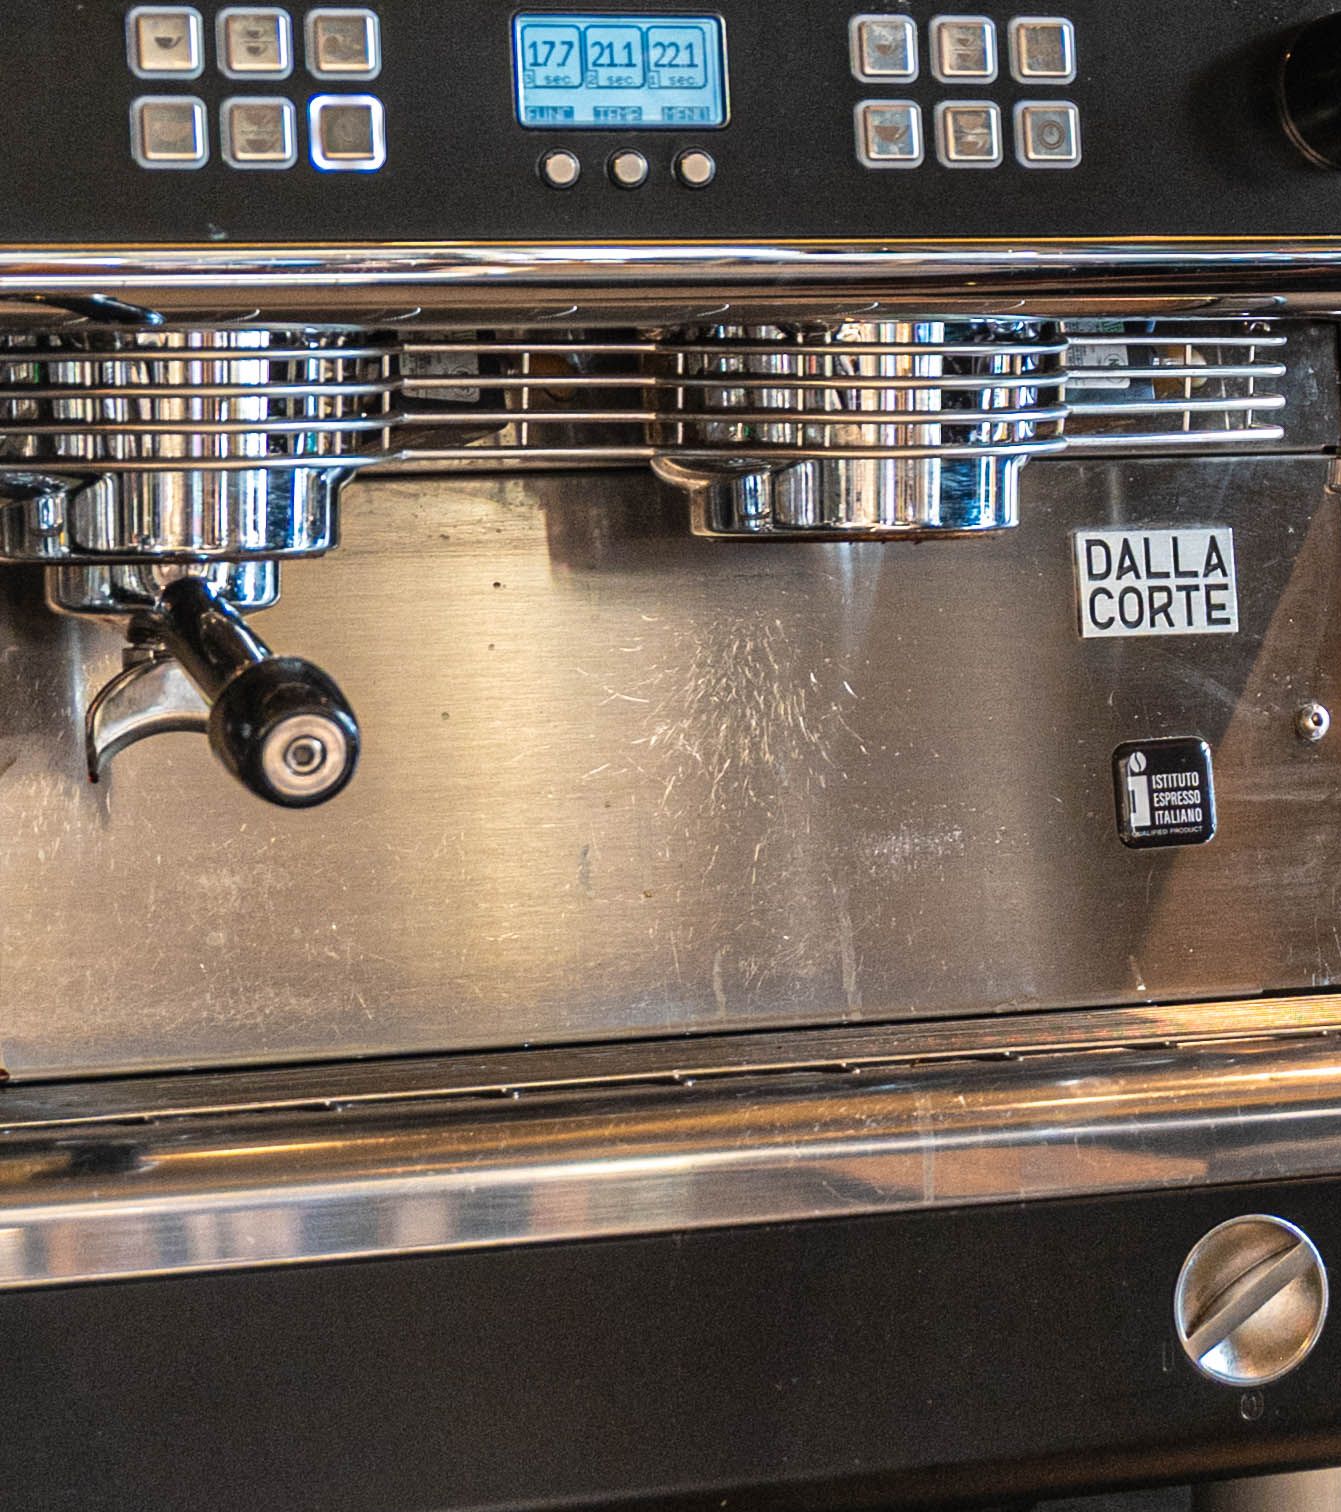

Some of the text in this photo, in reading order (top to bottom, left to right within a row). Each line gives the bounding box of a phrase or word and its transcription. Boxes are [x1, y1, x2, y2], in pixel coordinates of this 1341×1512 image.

[1085, 535, 1229, 582] DALLA
[1089, 583, 1232, 630] CORTE
[1151, 771, 1200, 790] ISTITUTO
[1153, 789, 1201, 808] ESPRESSO
[1154, 807, 1203, 826] ITALIANO
